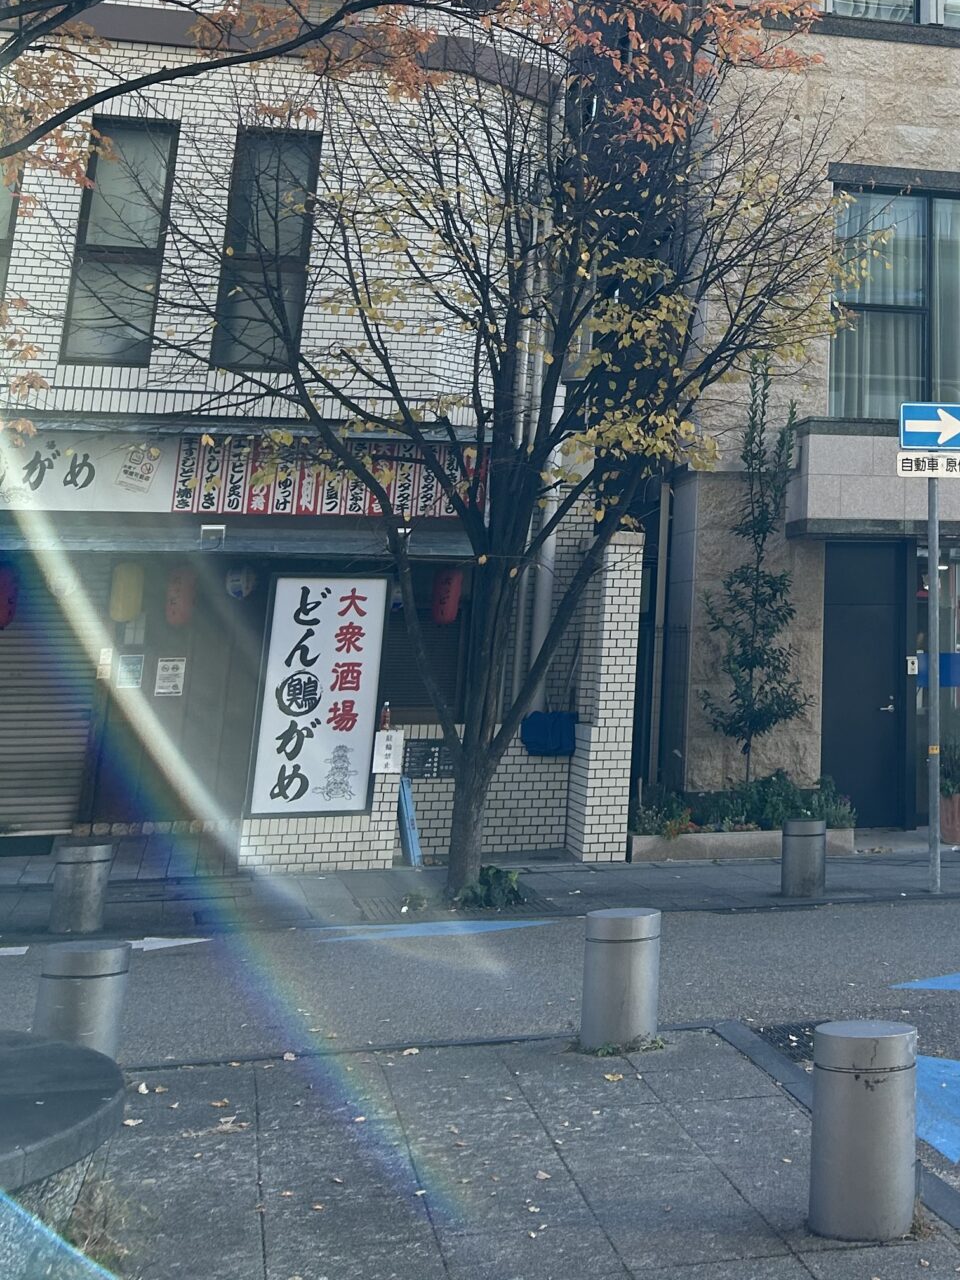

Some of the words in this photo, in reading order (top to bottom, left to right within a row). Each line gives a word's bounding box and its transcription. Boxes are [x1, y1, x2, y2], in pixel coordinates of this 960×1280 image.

[0, 449, 95, 491] がめ
[901, 457, 939, 472] 自動車
[326, 587, 368, 732] 大衆酒場
